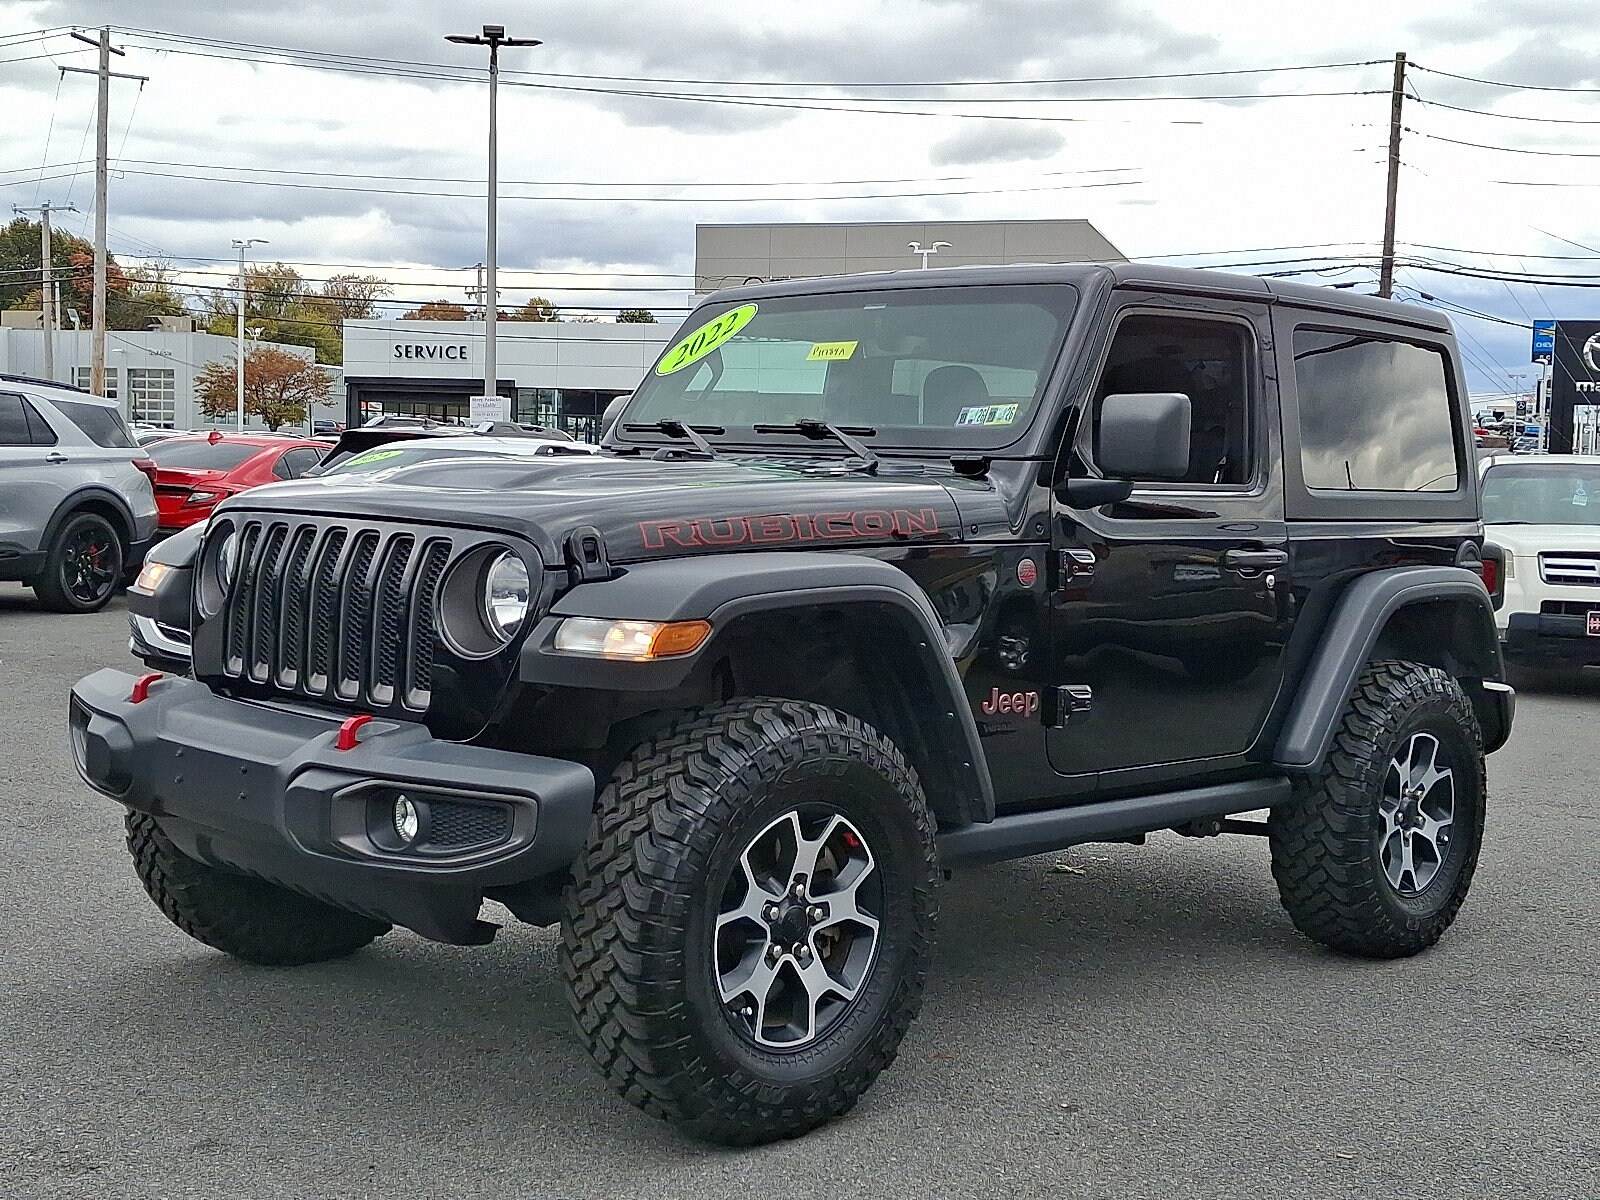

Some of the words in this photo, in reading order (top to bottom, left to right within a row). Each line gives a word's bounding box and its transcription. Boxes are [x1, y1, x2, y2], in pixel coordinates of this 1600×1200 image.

[393, 344, 468, 360] SERVICE
[672, 312, 739, 369] 2022
[638, 508, 939, 549] RUBICON
[981, 687, 1039, 718] Jeep
